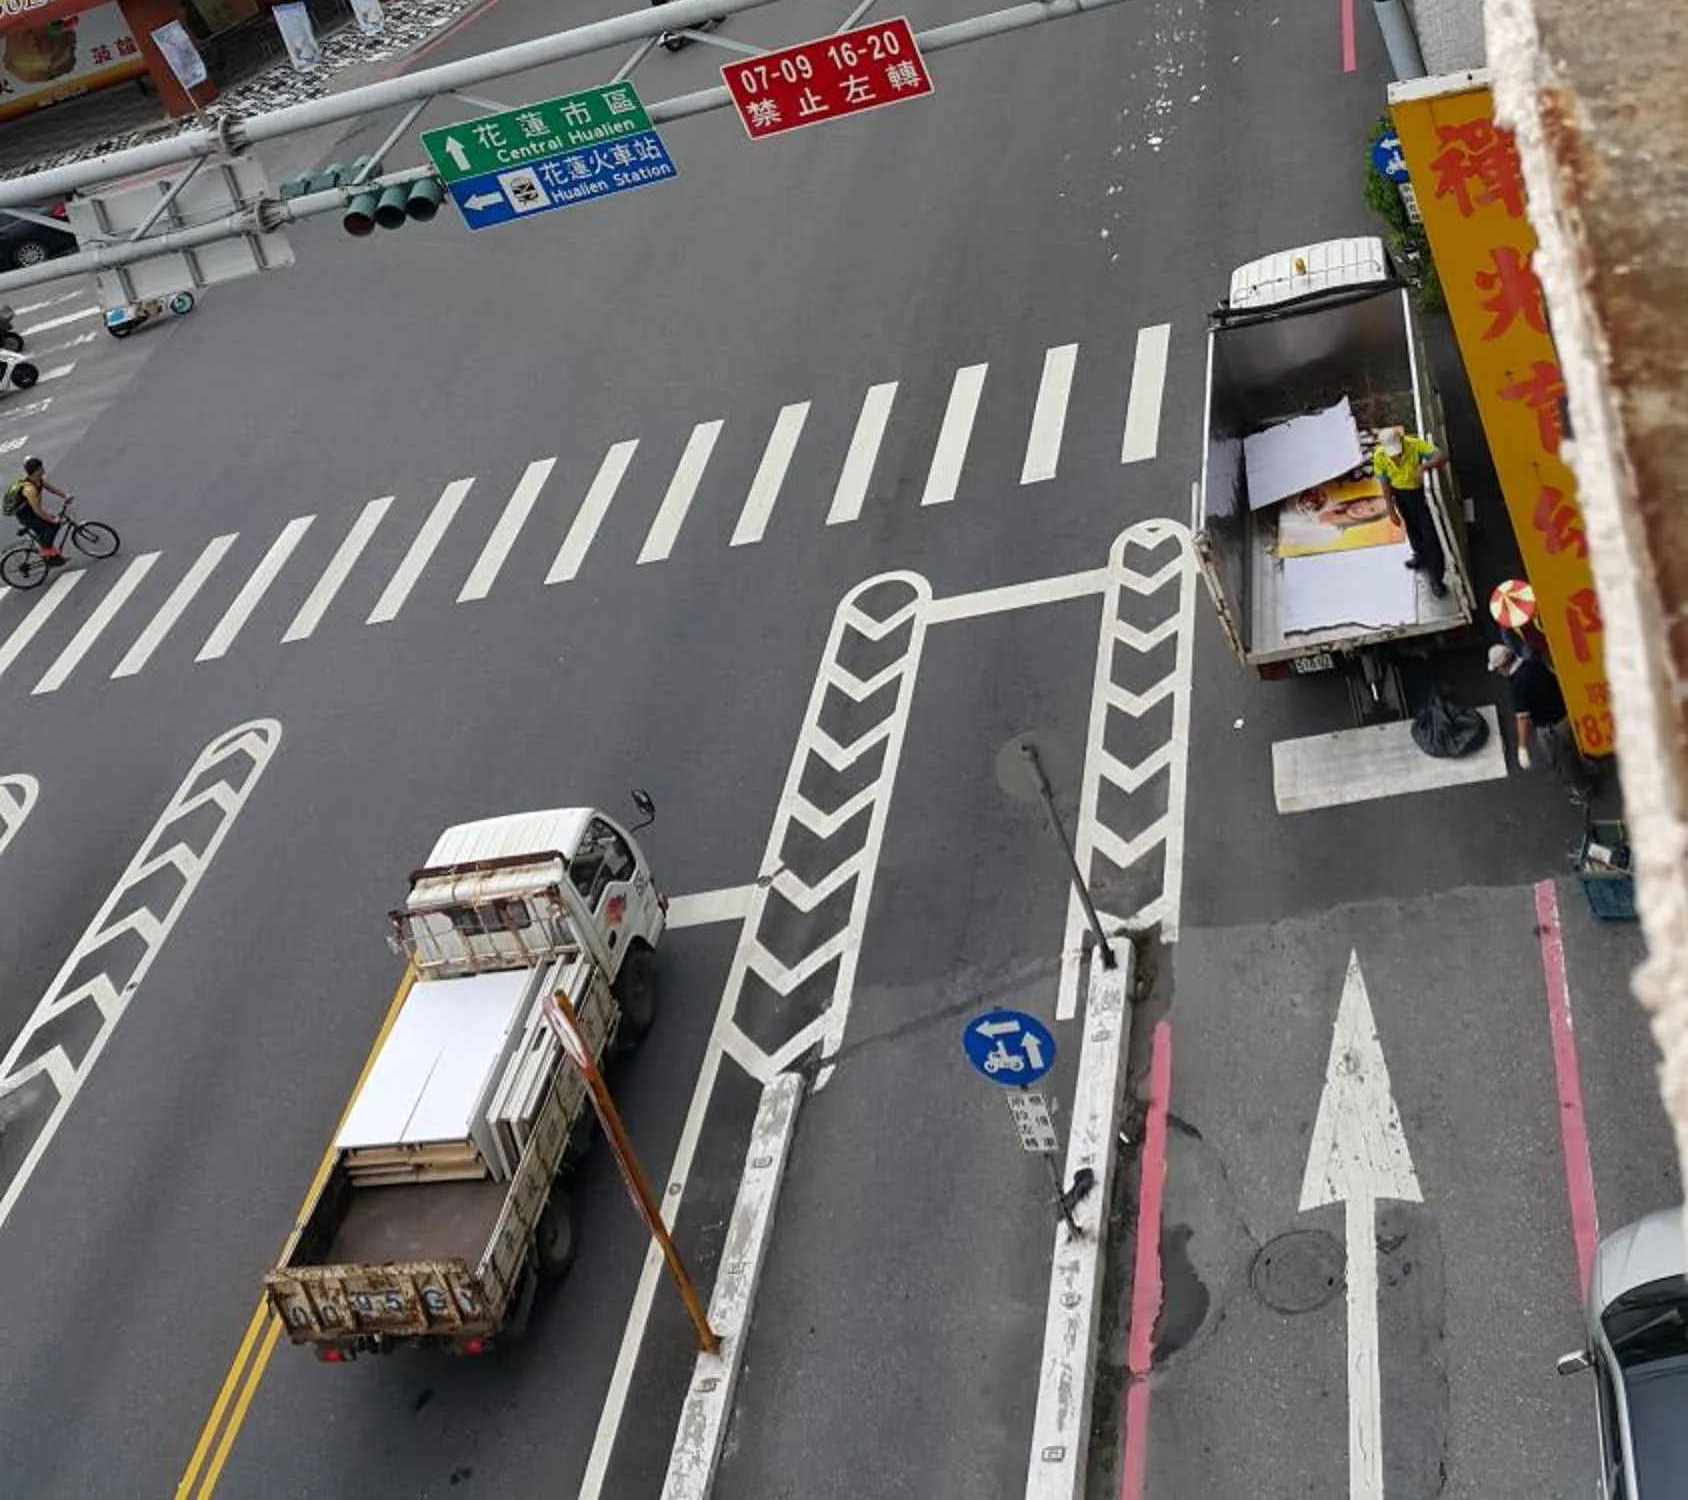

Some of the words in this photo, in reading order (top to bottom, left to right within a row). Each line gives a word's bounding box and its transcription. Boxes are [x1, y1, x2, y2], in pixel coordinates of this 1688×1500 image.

[740, 59, 813, 95] 07-09
[826, 30, 900, 71] 16-20
[472, 88, 637, 149] 花蓮市區
[745, 60, 919, 127] 禁止左轉
[496, 136, 564, 164] Central
[567, 119, 636, 146] Hualien
[538, 136, 663, 187] 花蓮火車站
[551, 179, 609, 205] Hualien
[612, 162, 672, 188] Station
